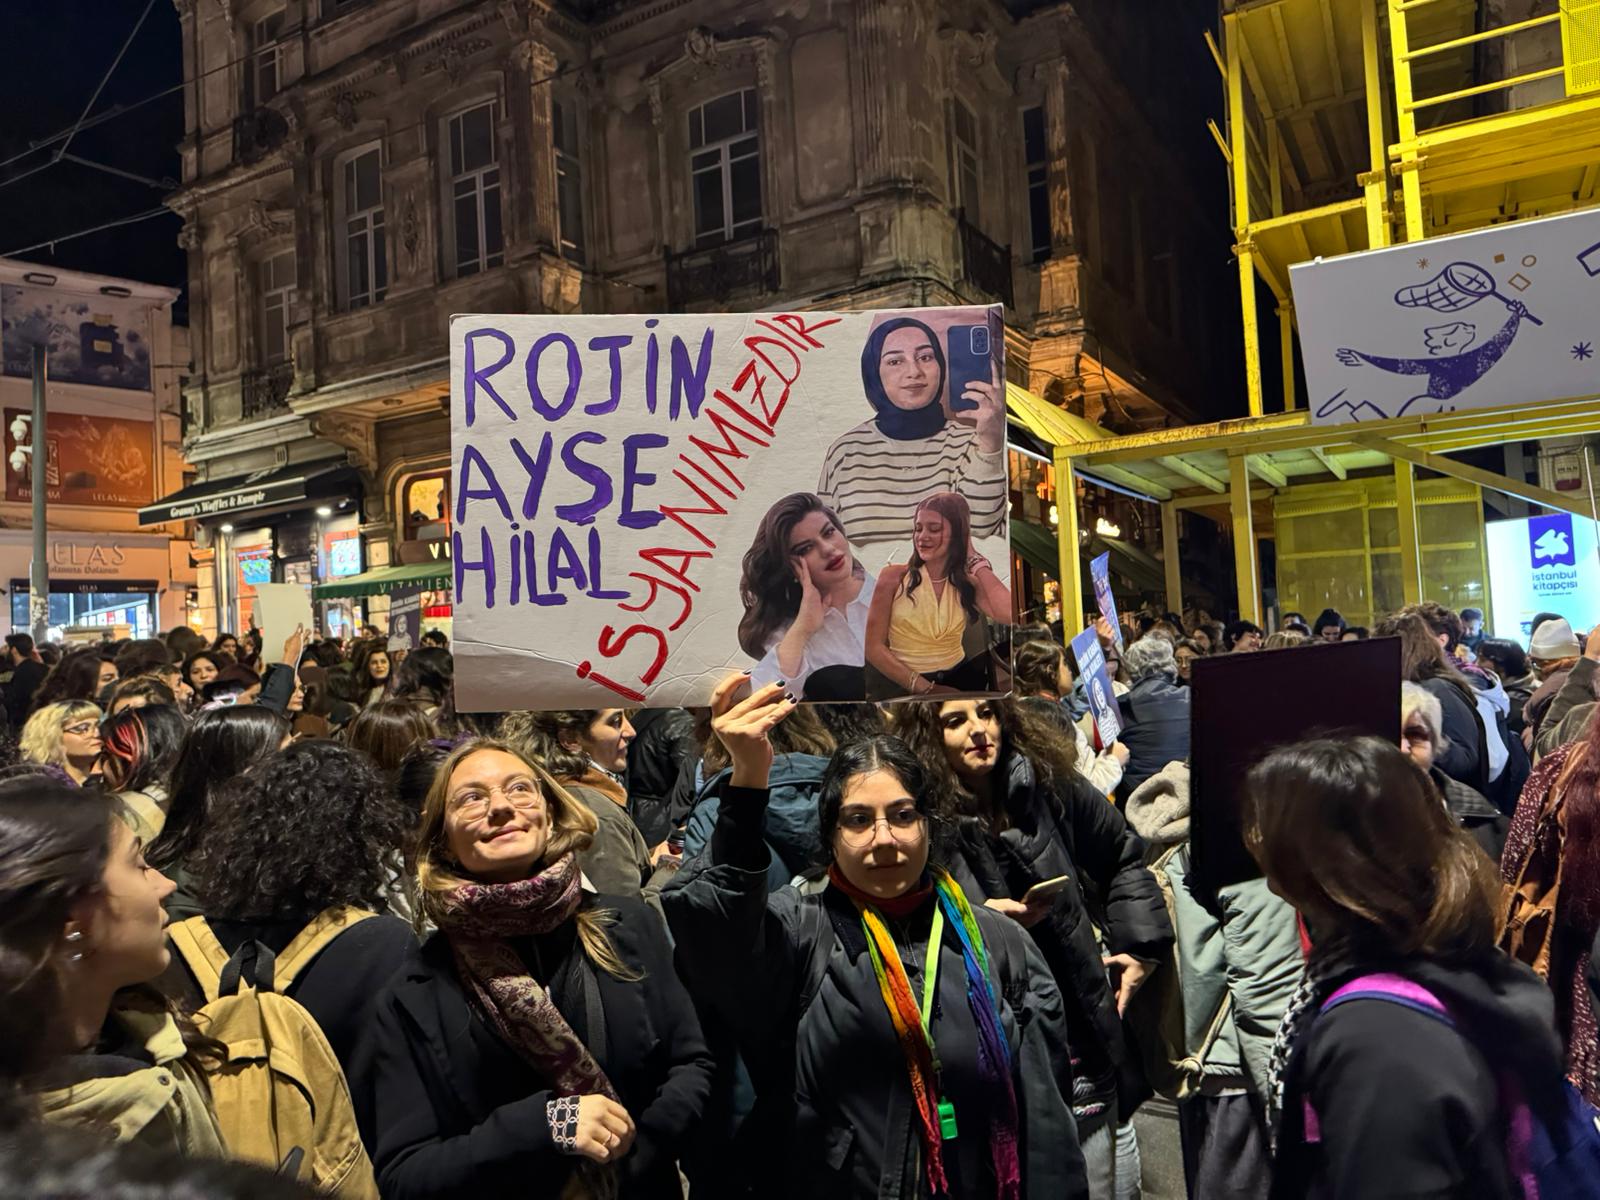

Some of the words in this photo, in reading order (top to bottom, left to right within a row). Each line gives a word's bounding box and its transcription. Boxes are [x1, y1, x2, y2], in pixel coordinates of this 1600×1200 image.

[463, 318, 715, 428] ROJİN
[201, 498, 229, 513] Waffles
[229, 496, 237, 507] &
[575, 314, 843, 703] İSYANIMIZDIR
[53, 542, 126, 566] ELAS
[452, 521, 632, 609] HİLAL
[1532, 570, 1577, 582] istanbul
[1532, 581, 1578, 591] kitapçısı
